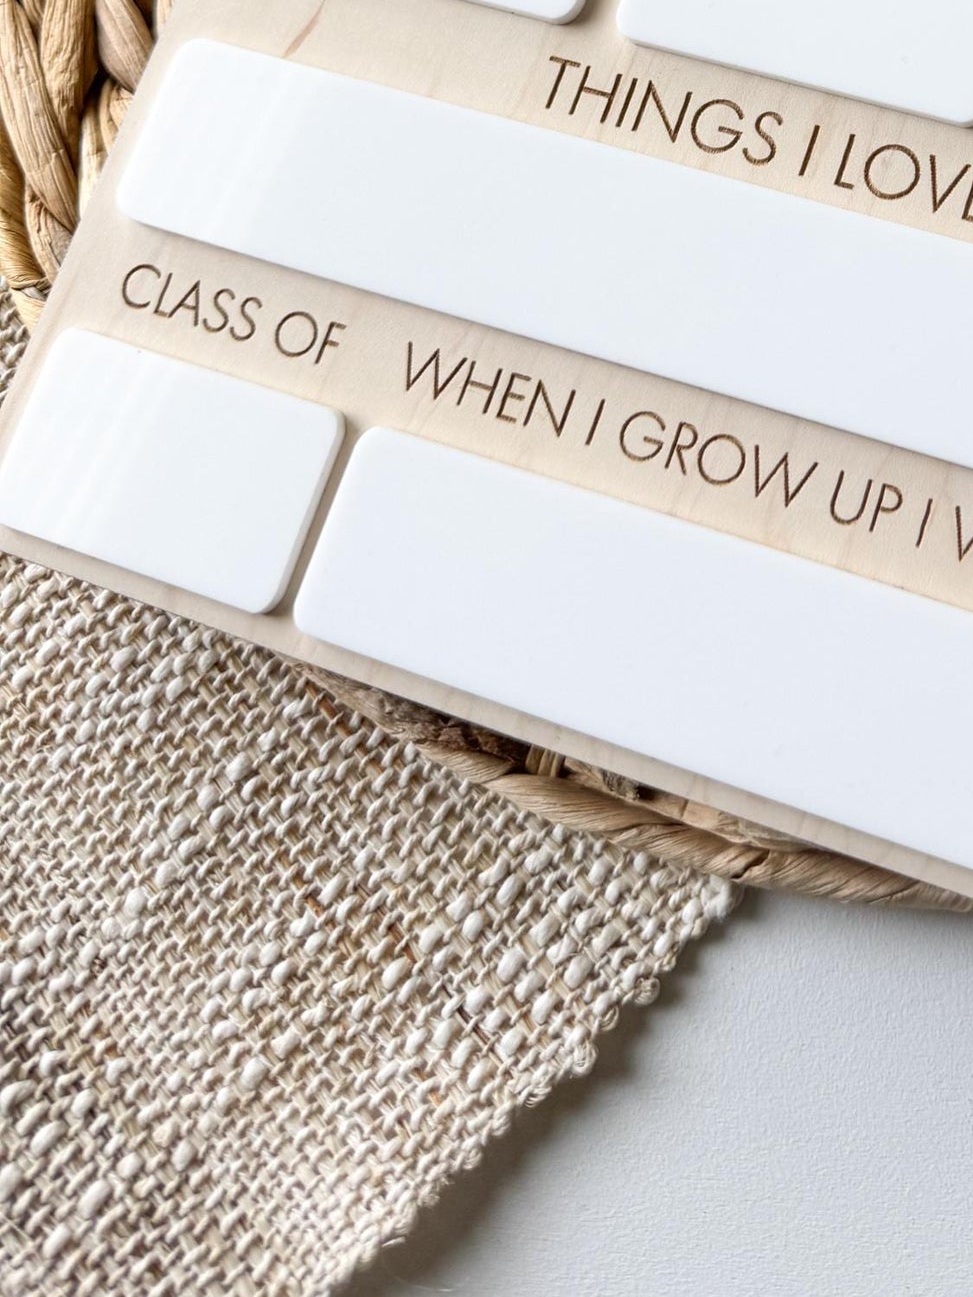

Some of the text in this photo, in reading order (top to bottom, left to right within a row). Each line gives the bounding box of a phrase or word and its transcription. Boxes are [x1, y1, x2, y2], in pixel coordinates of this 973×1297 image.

[545, 54, 783, 165] THINGS
[798, 124, 820, 177] I
[122, 263, 347, 365] CLASS OF
[406, 340, 577, 436] WHEN
[584, 399, 606, 447] I
[619, 410, 818, 507] GROW
[830, 469, 904, 533] UP
[916, 498, 934, 547] I
